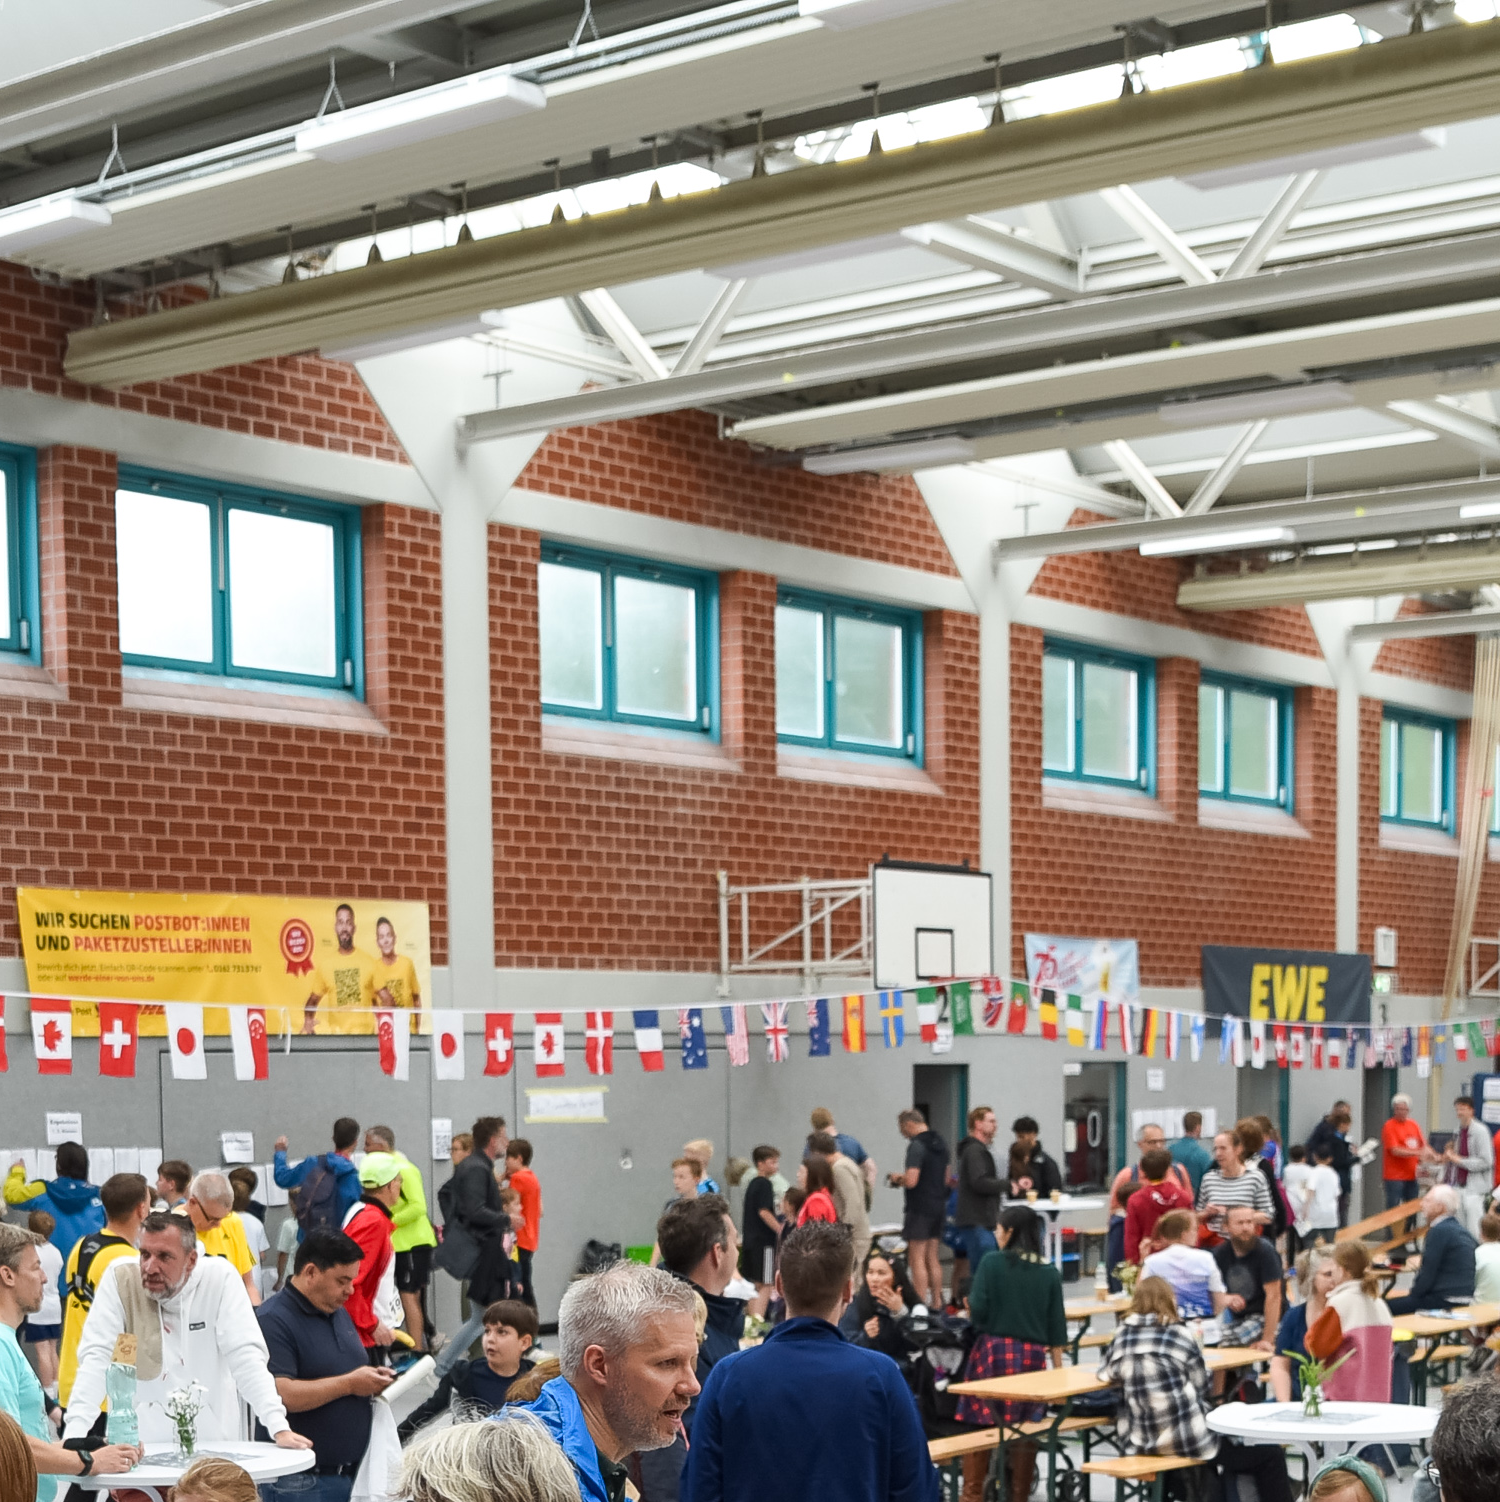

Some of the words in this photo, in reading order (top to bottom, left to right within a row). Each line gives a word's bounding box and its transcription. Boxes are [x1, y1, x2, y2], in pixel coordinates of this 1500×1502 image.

[35, 912, 65, 928] WIR
[69, 913, 130, 930] SUCHEN
[134, 915, 250, 932] POSTBOT:INNEN
[36, 935, 70, 951] UND
[74, 936, 252, 954] PAKETZUSTELLER:INNEN
[1251, 963, 1329, 1022] EWE
